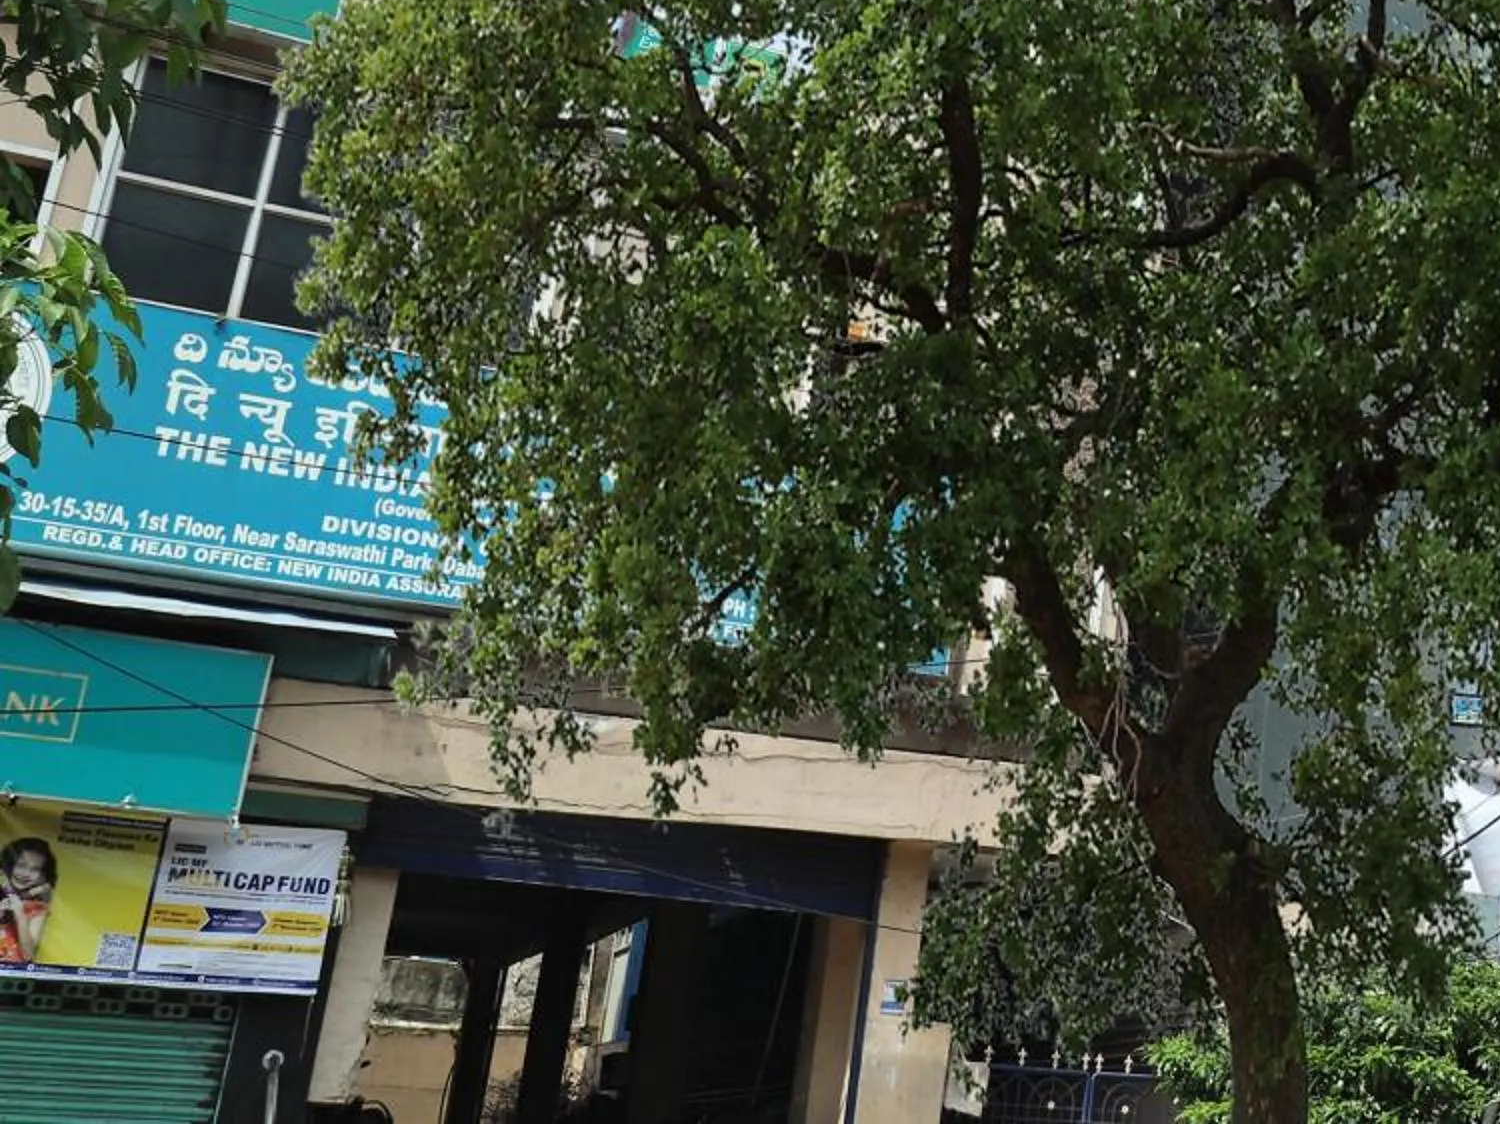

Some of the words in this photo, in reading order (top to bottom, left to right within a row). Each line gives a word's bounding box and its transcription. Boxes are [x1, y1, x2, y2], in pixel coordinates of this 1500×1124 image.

[165, 369, 215, 420] दि
[239, 393, 295, 447] न्यू
[154, 426, 232, 467] THE
[239, 441, 327, 482] NEW
[334, 456, 432, 497] INDIA
[18, 490, 129, 530] 30-15-35/A,
[137, 508, 170, 533] 1st
[173, 514, 227, 544] Floor,
[232, 523, 280, 549] Near
[283, 531, 386, 565] Saraswathi
[130, 537, 188, 560] HEAD
[193, 548, 272, 573] OFFICE:
[277, 558, 322, 580] NEW
[327, 568, 381, 589] INDIA
[386, 578, 463, 600] ASSURA
[277, 876, 332, 895] FUND
